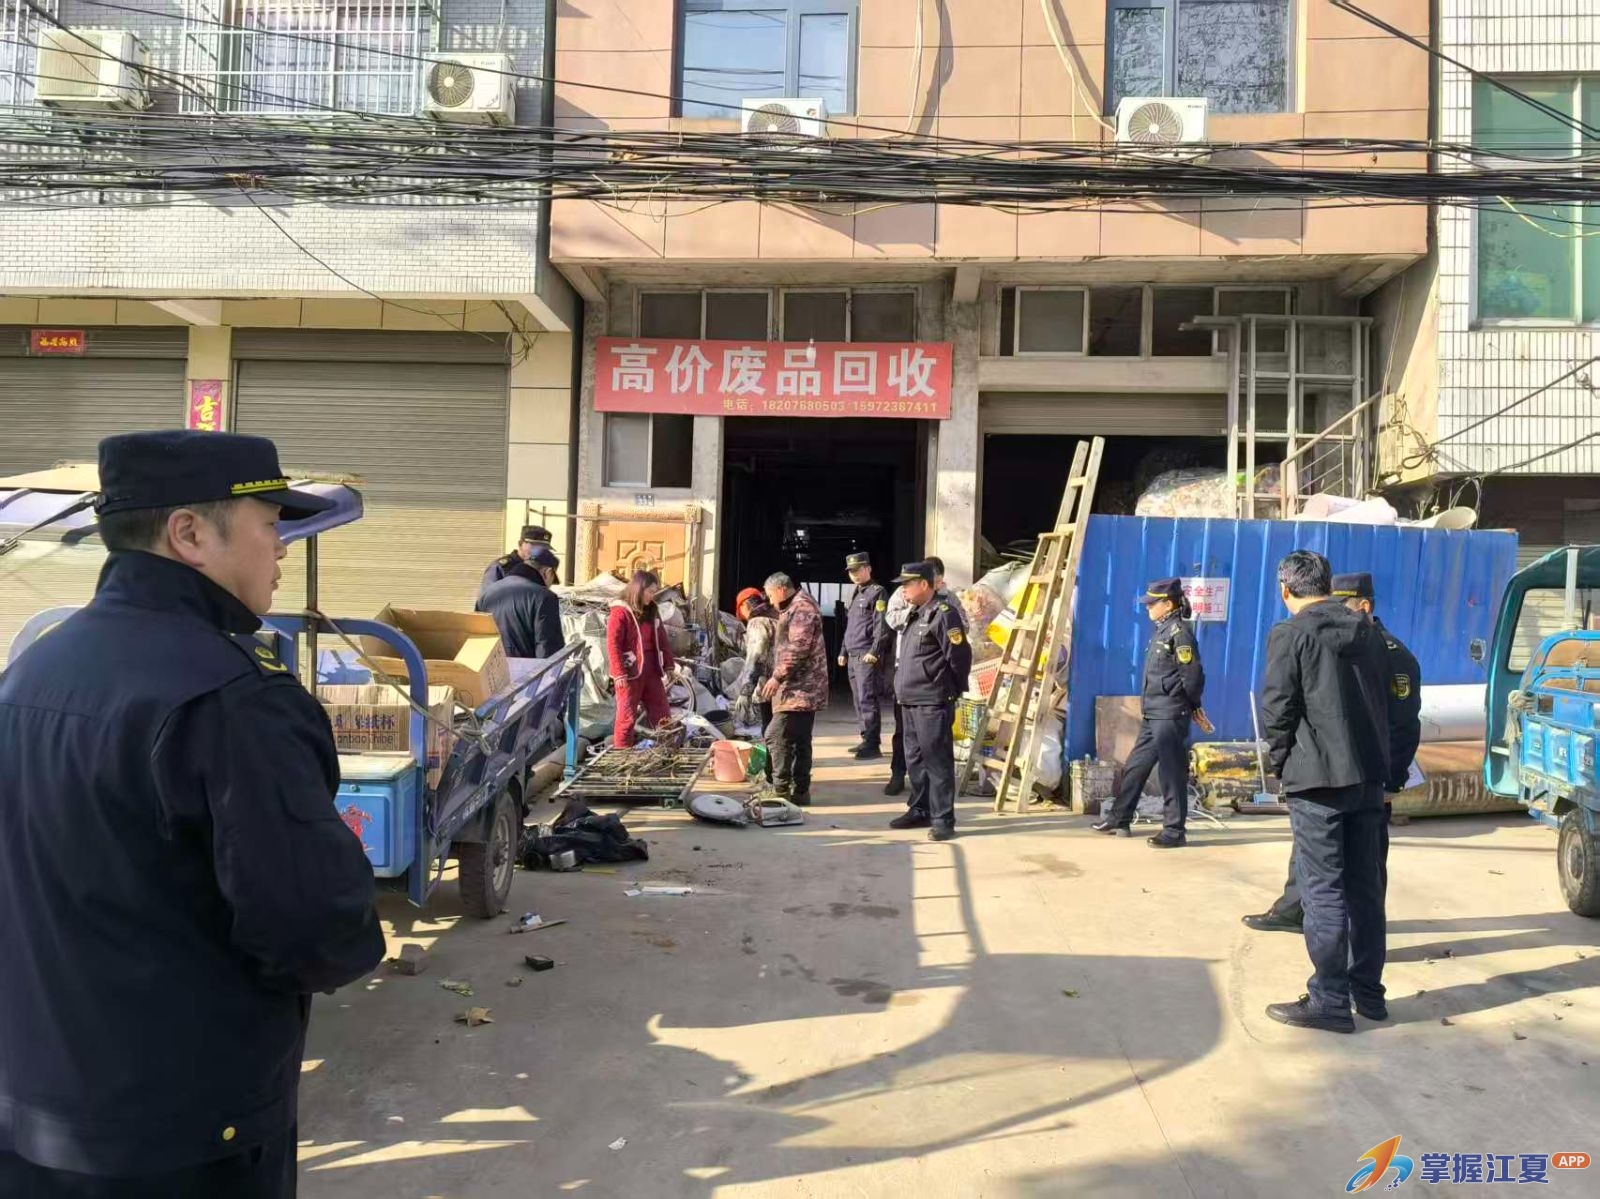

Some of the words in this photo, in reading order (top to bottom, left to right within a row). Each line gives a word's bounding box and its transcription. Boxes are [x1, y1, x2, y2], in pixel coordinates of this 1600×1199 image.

[610, 344, 937, 397] 高价废品回收
[1190, 602, 1225, 614] 明施工
